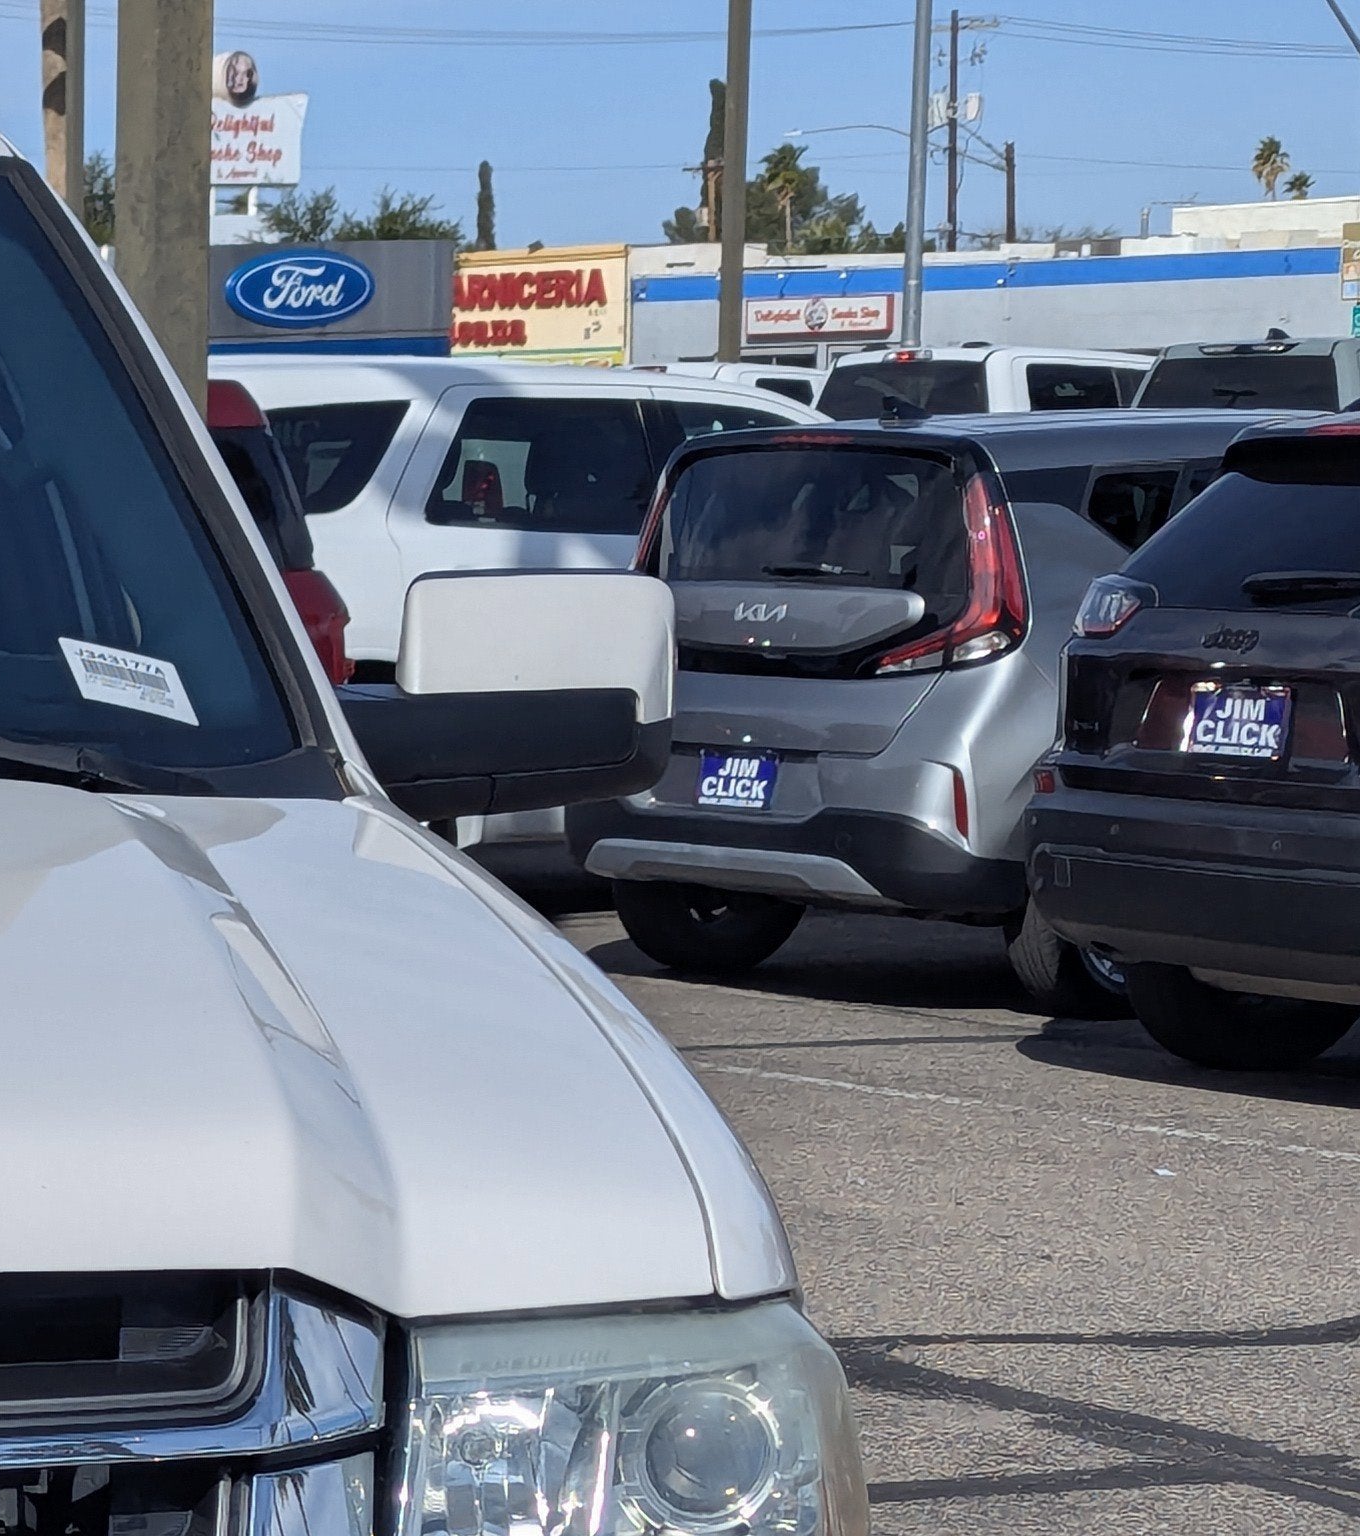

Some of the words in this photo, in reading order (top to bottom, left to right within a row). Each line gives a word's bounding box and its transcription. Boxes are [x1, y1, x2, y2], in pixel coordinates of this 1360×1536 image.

[262, 264, 346, 309] Ford
[452, 267, 608, 312] ARNICERIA
[733, 601, 788, 623] KIA
[1216, 697, 1266, 721] JIM
[1195, 719, 1280, 749] CLICK
[717, 756, 761, 779] JIM
[701, 776, 768, 800] CLICK
